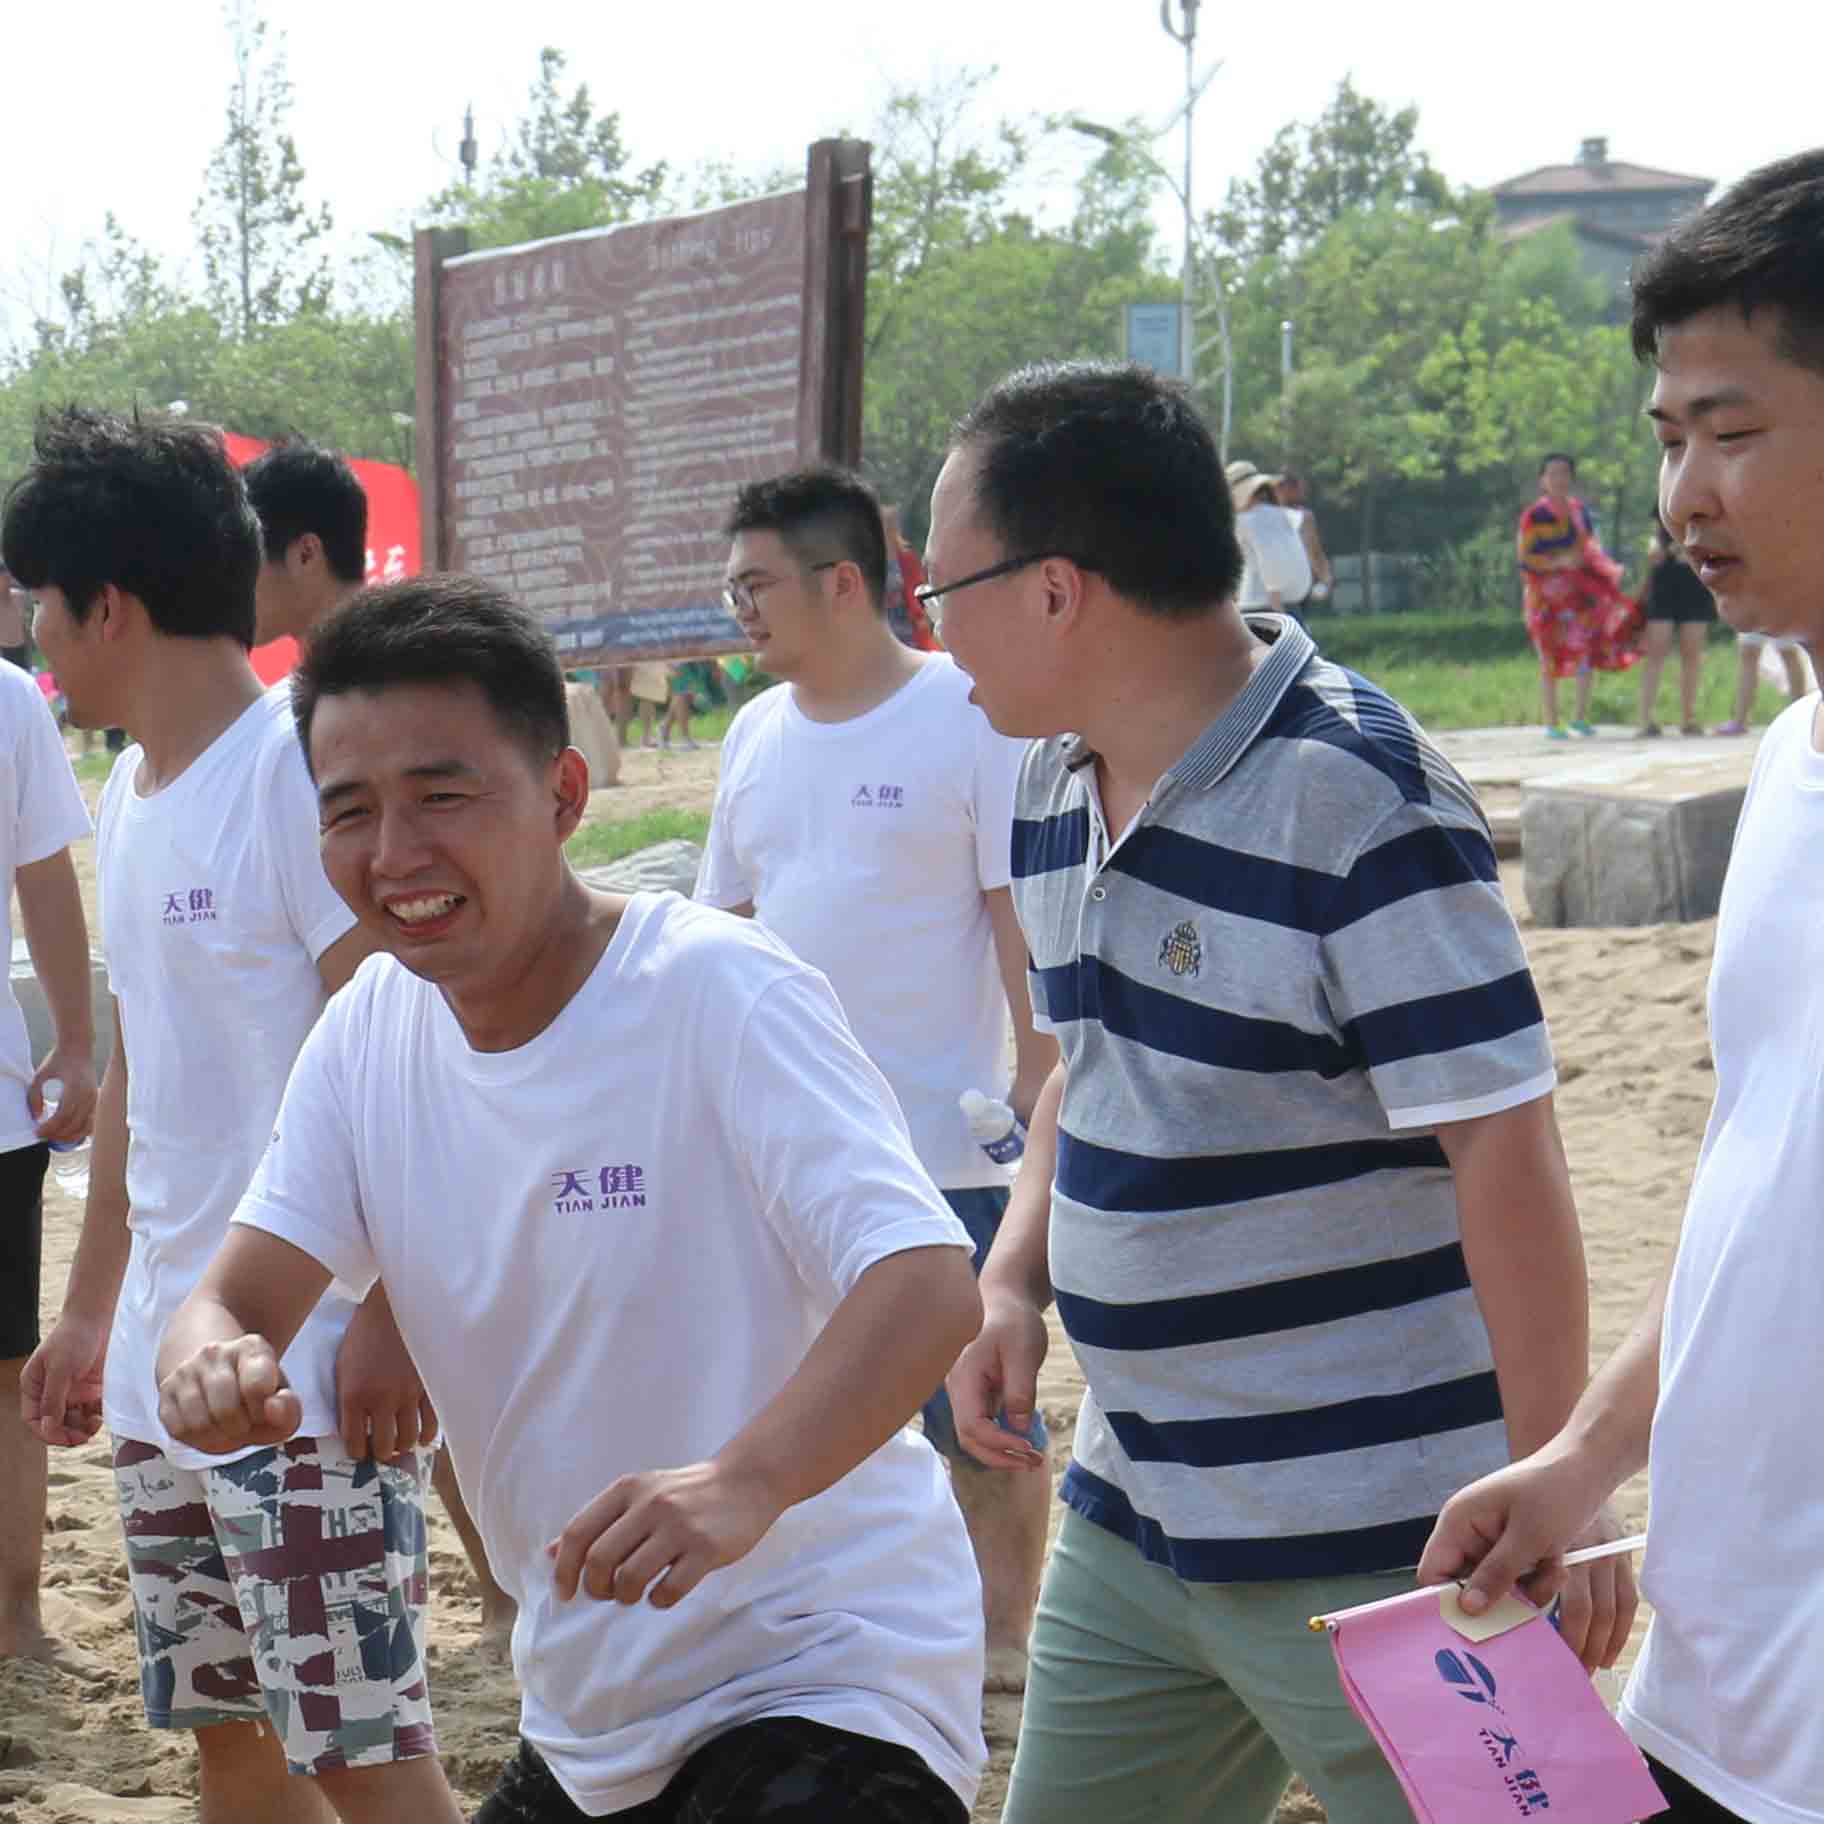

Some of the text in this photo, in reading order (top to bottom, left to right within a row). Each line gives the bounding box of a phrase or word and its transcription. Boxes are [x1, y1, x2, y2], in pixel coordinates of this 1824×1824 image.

[160, 888, 217, 914] 天健
[550, 1164, 647, 1199] 天健
[554, 1194, 646, 1215] TIAN JIAN
[1479, 1727, 1532, 1817] TIAN JIAN
[1486, 1727, 1550, 1810] 天健
